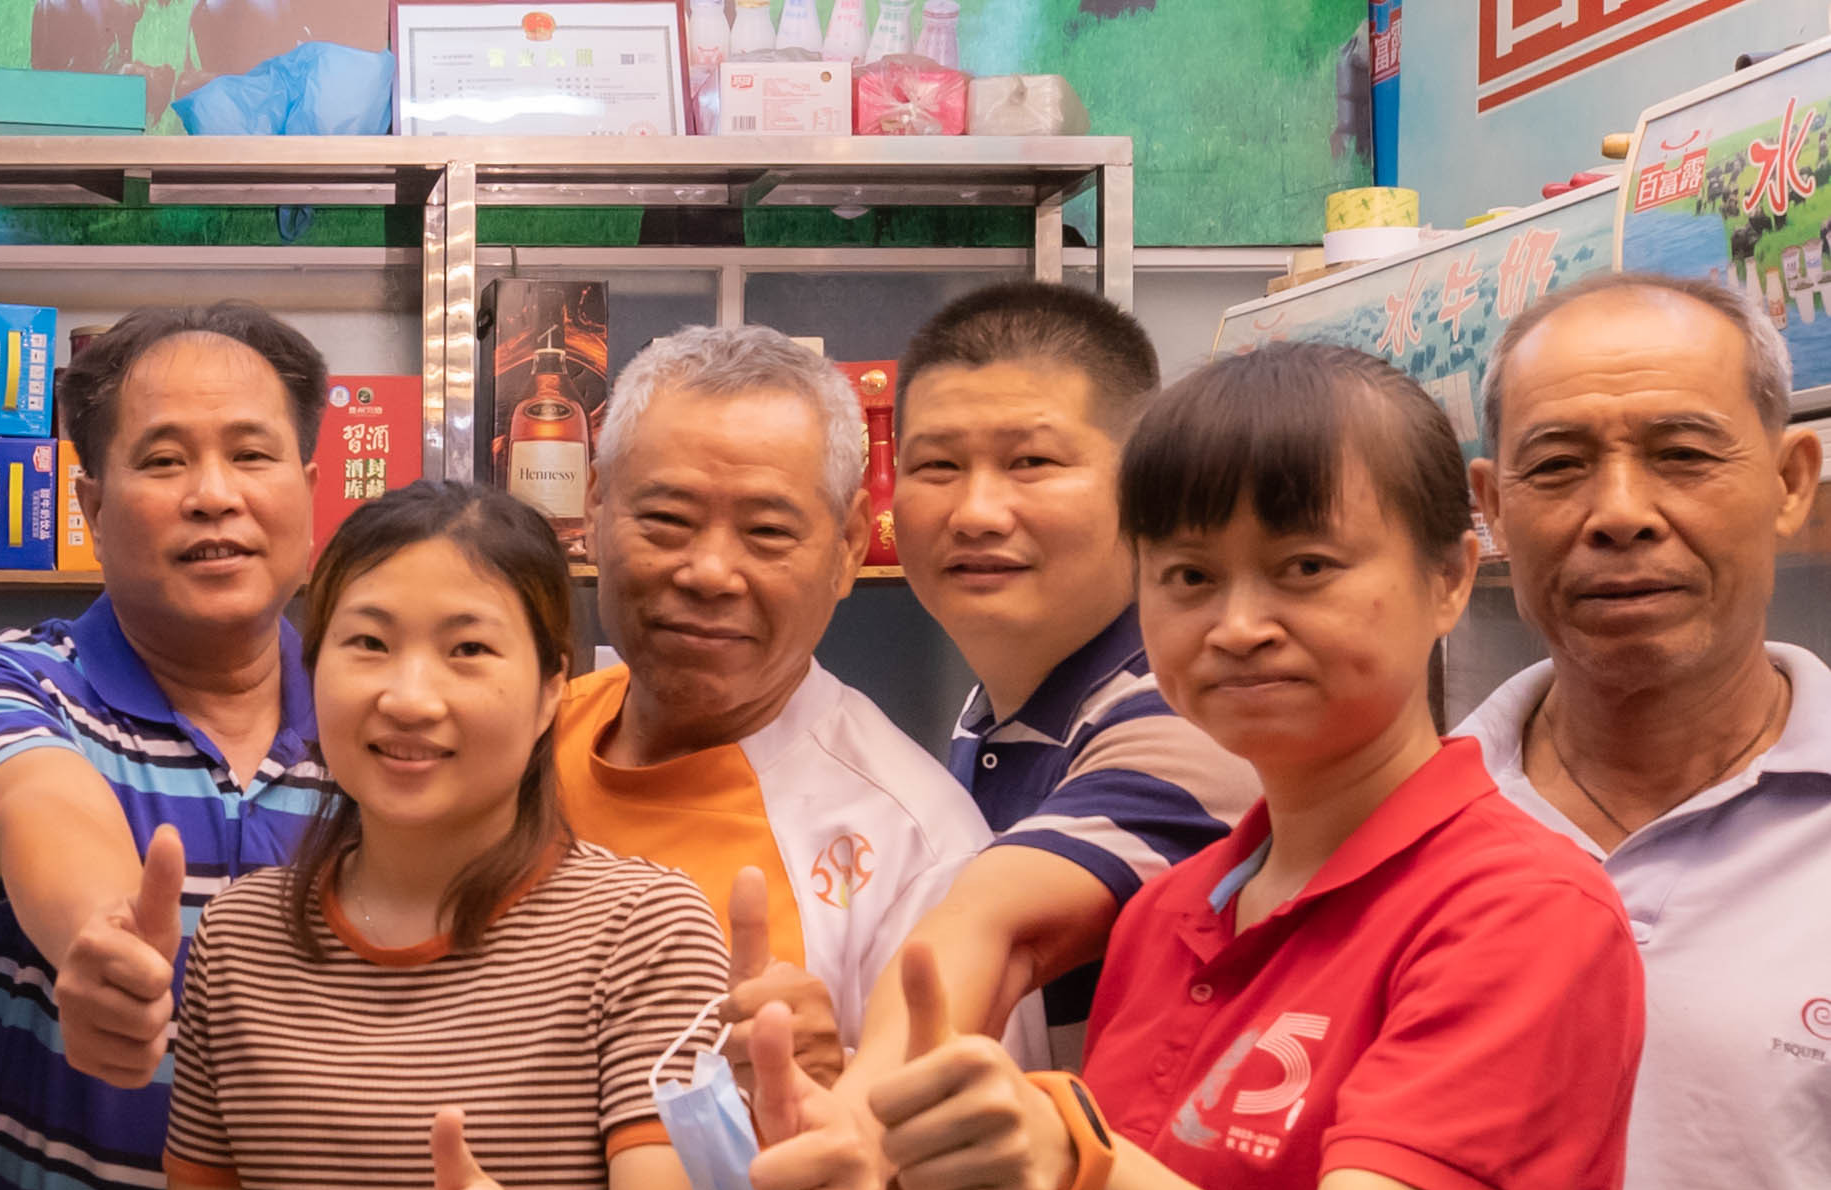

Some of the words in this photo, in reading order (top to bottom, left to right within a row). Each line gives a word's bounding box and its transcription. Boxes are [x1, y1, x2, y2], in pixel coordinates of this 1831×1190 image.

[1636, 154, 1706, 205] 百富露
[1743, 97, 1817, 216] 水
[1376, 226, 1561, 357] 水牛奶
[519, 467, 578, 489] Hennessy
